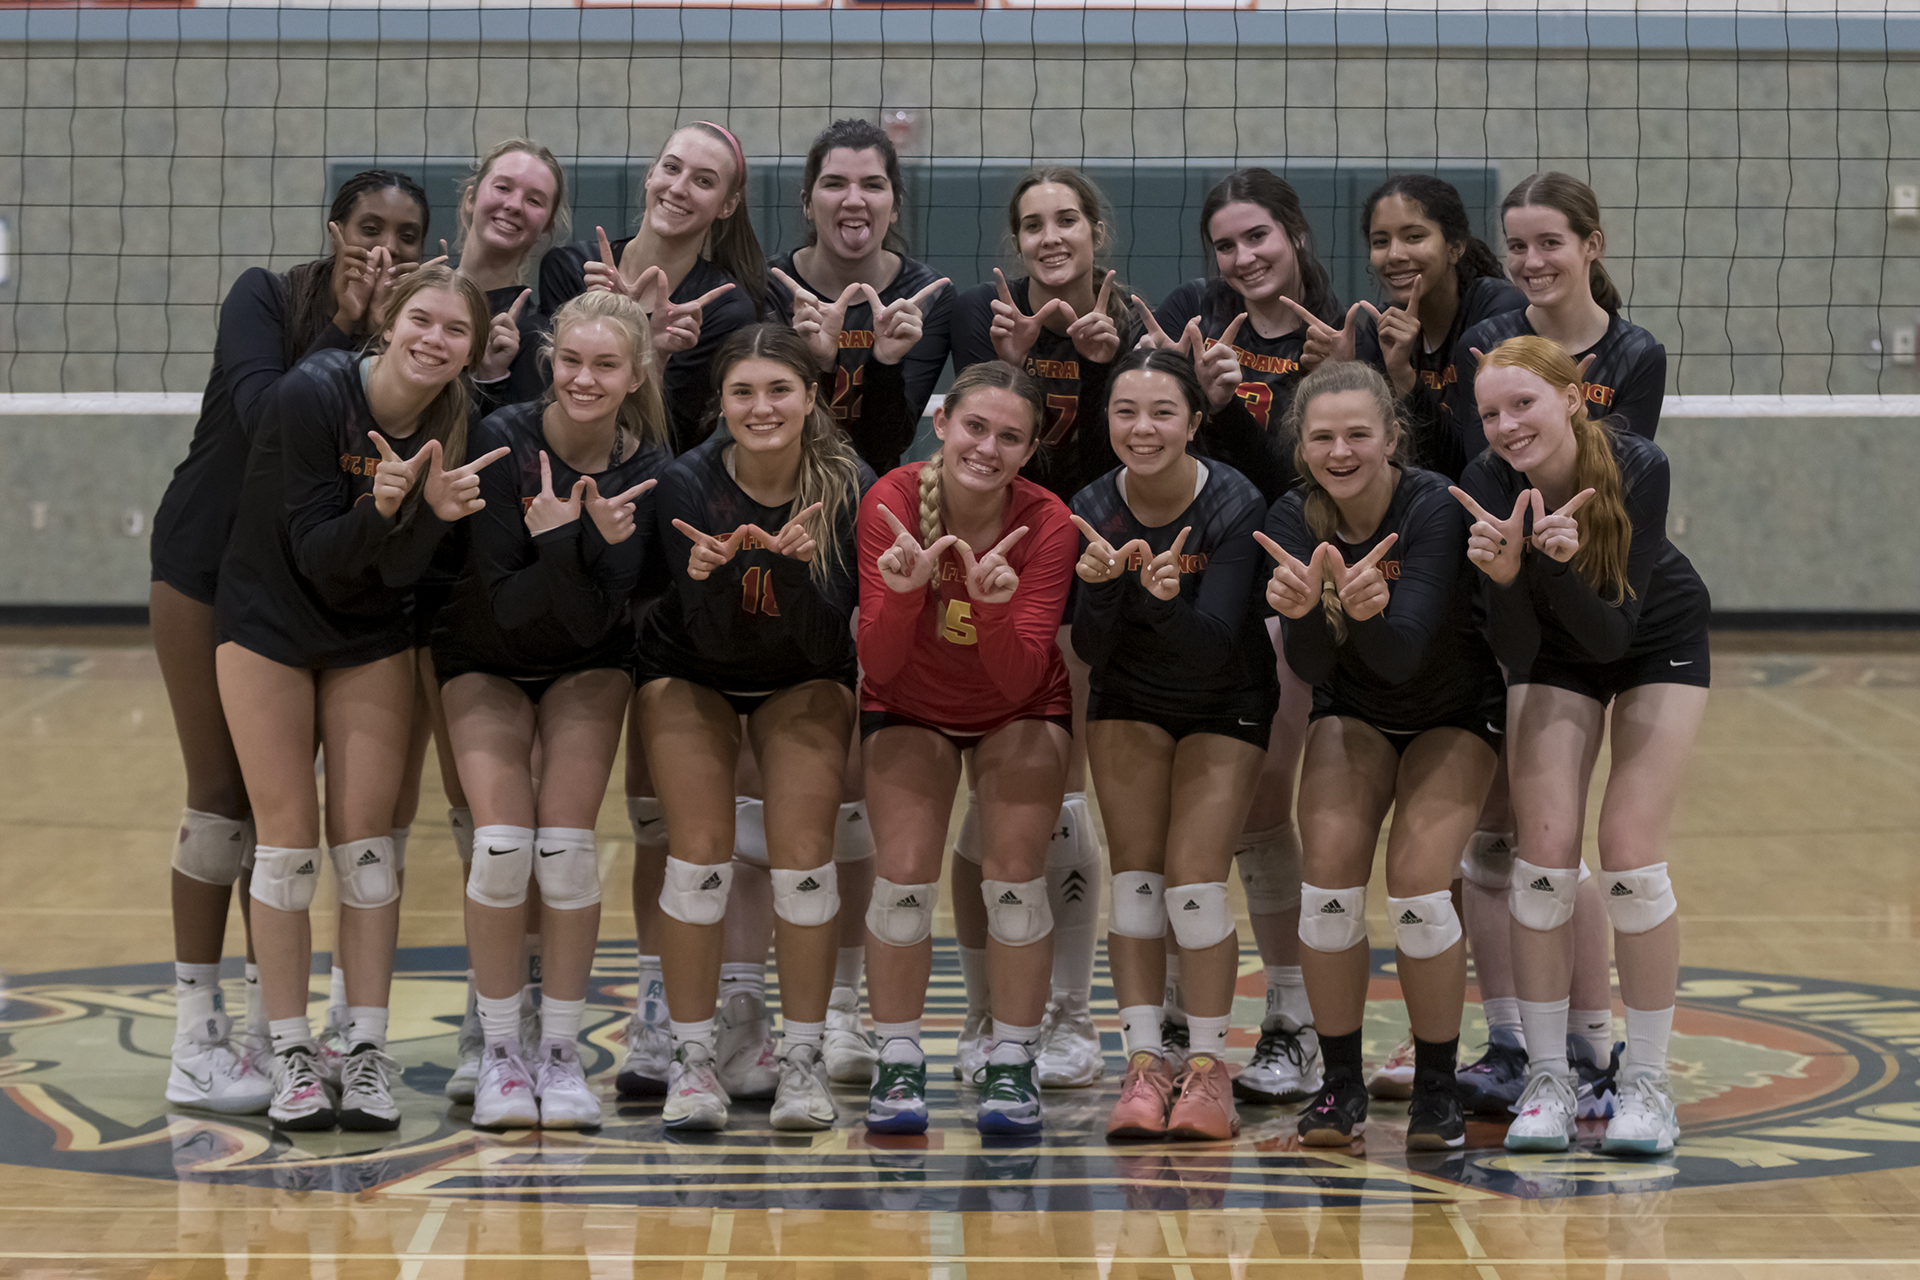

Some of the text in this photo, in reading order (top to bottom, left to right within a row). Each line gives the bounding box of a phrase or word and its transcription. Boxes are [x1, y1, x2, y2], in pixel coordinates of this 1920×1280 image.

[1041, 393, 1078, 446] 7
[942, 599, 978, 645] 5
[1529, 883, 1555, 892] adidas
